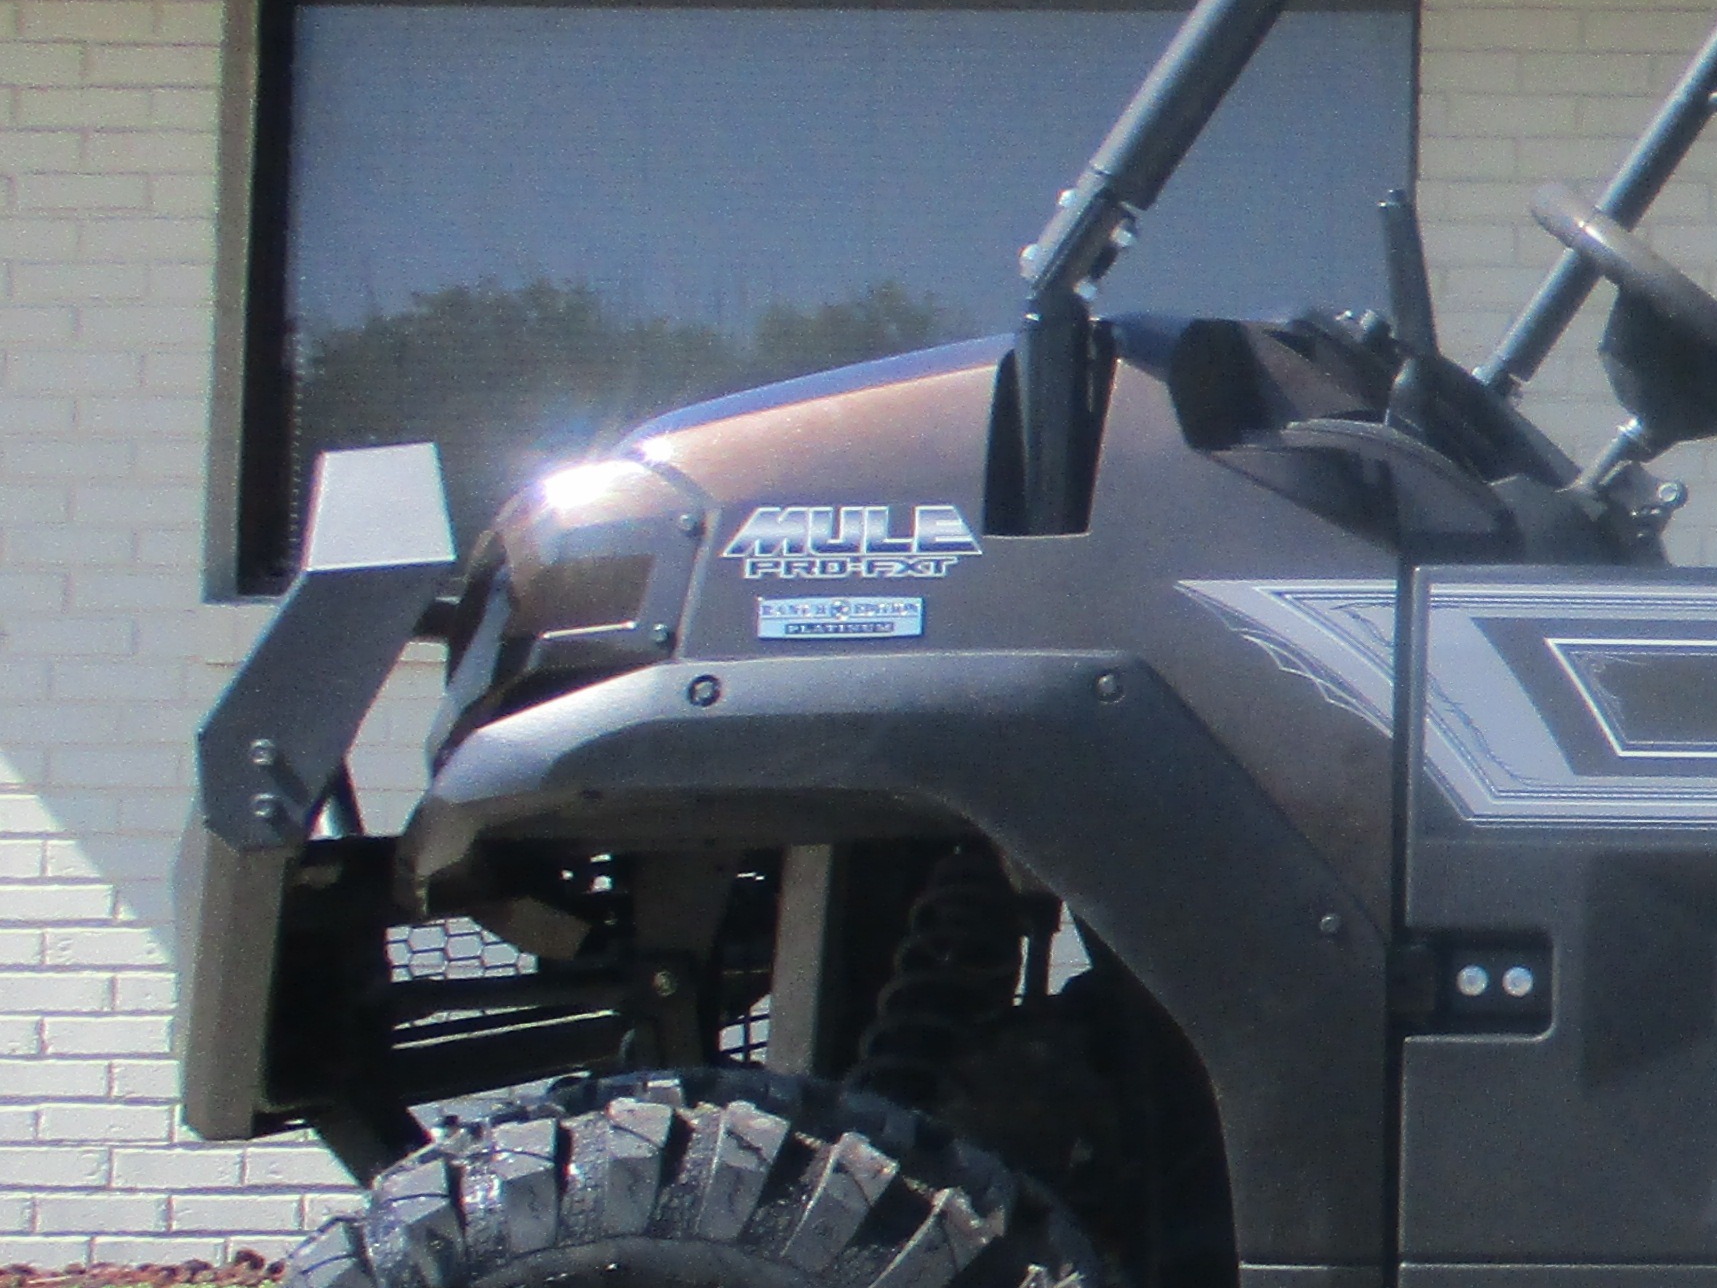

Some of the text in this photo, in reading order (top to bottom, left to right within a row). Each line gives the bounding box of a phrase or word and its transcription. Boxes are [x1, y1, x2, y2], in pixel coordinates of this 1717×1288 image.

[721, 506, 983, 557] MULE
[744, 557, 958, 580] PRO-FXT
[786, 622, 893, 634] PLATINUM
